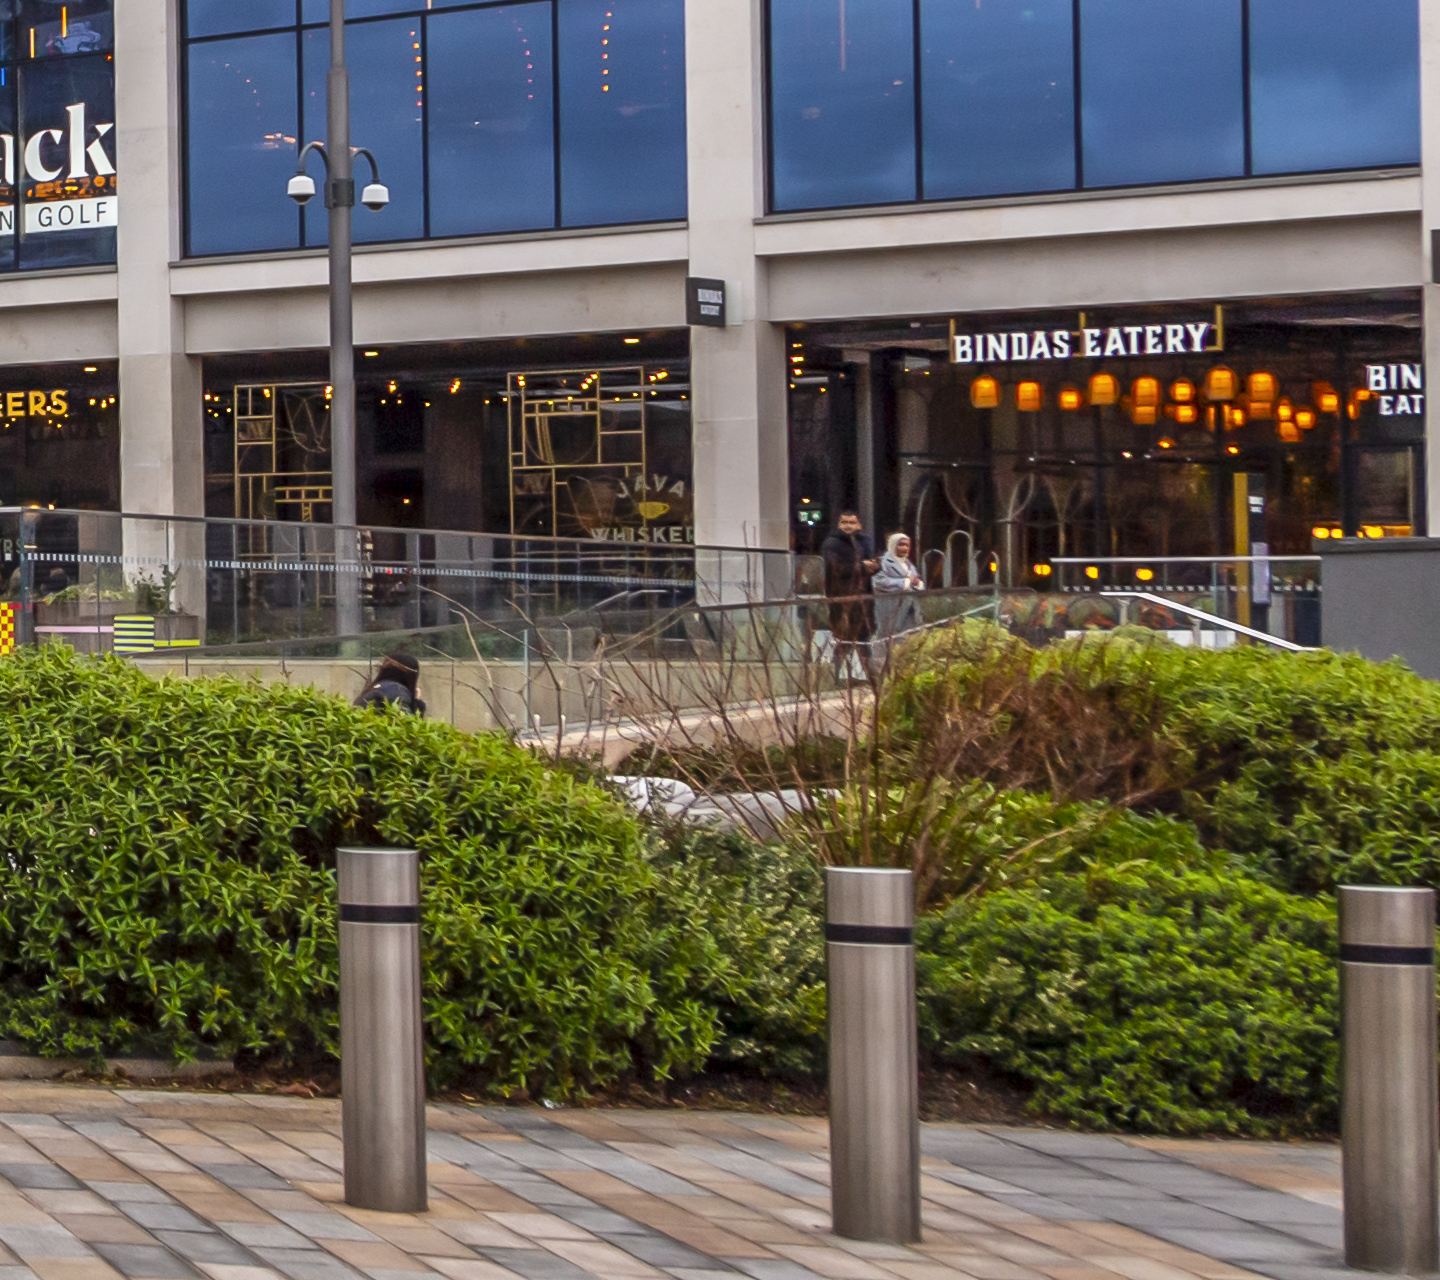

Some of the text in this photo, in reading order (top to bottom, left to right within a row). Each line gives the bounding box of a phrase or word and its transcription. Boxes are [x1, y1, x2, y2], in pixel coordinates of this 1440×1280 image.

[37, 201, 108, 227] GOLF
[953, 322, 1211, 363] BINDAS EATERY
